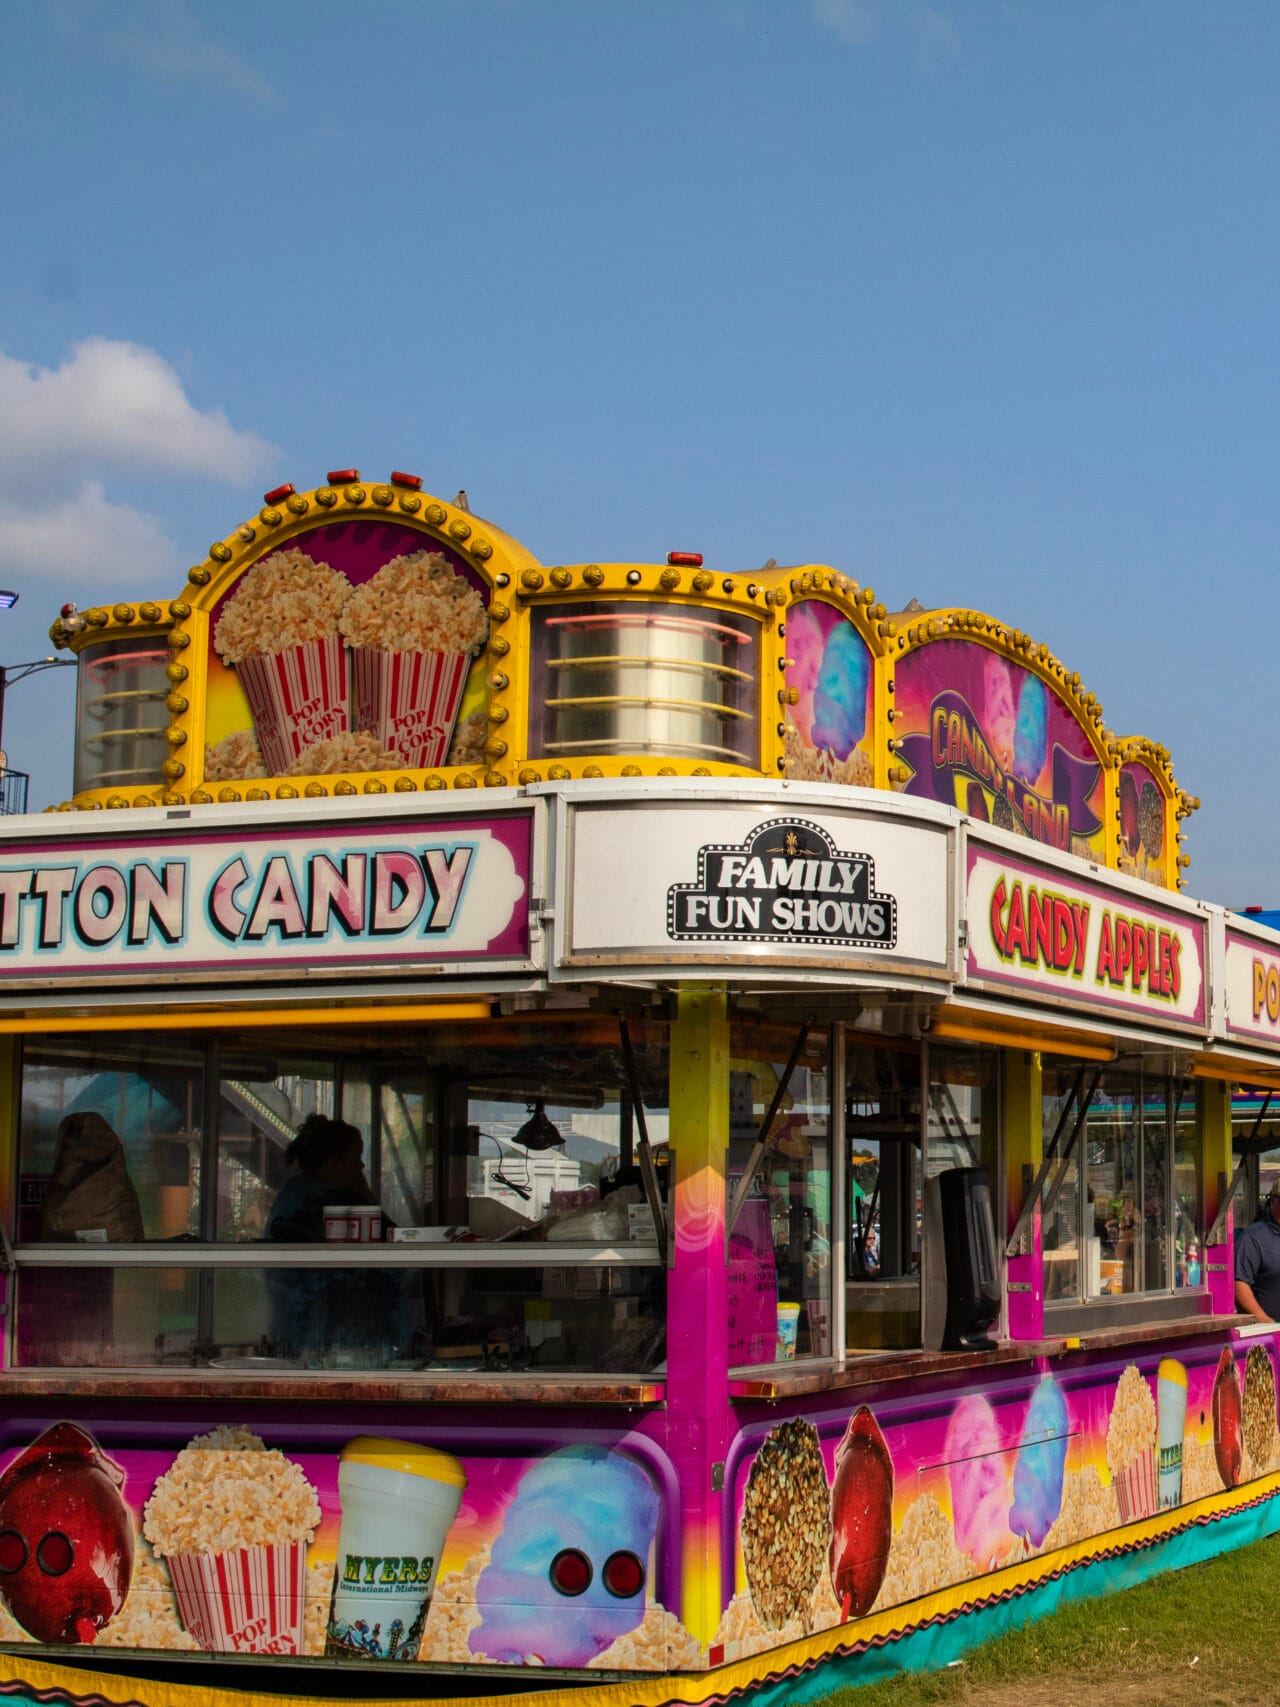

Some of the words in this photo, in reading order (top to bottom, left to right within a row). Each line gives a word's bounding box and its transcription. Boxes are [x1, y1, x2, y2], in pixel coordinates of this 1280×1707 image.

[289, 698, 321, 727] POP
[302, 704, 346, 745] CORN
[392, 710, 428, 733] POP
[398, 724, 446, 754] CORN
[932, 707, 1004, 790] CANDY
[1006, 777, 1070, 853] LAND
[717, 856, 863, 894] FAMILY
[0, 862, 185, 949] TTON
[209, 846, 474, 943] CANDY
[685, 895, 762, 929] FUN
[771, 897, 886, 937] SHOWS
[990, 879, 1090, 975] CANDY
[1098, 911, 1182, 999] APPLES
[340, 1581, 393, 1594] International
[395, 1584, 429, 1594] Midways
[343, 1554, 434, 1585] MYERS
[231, 1617, 269, 1651] POP
